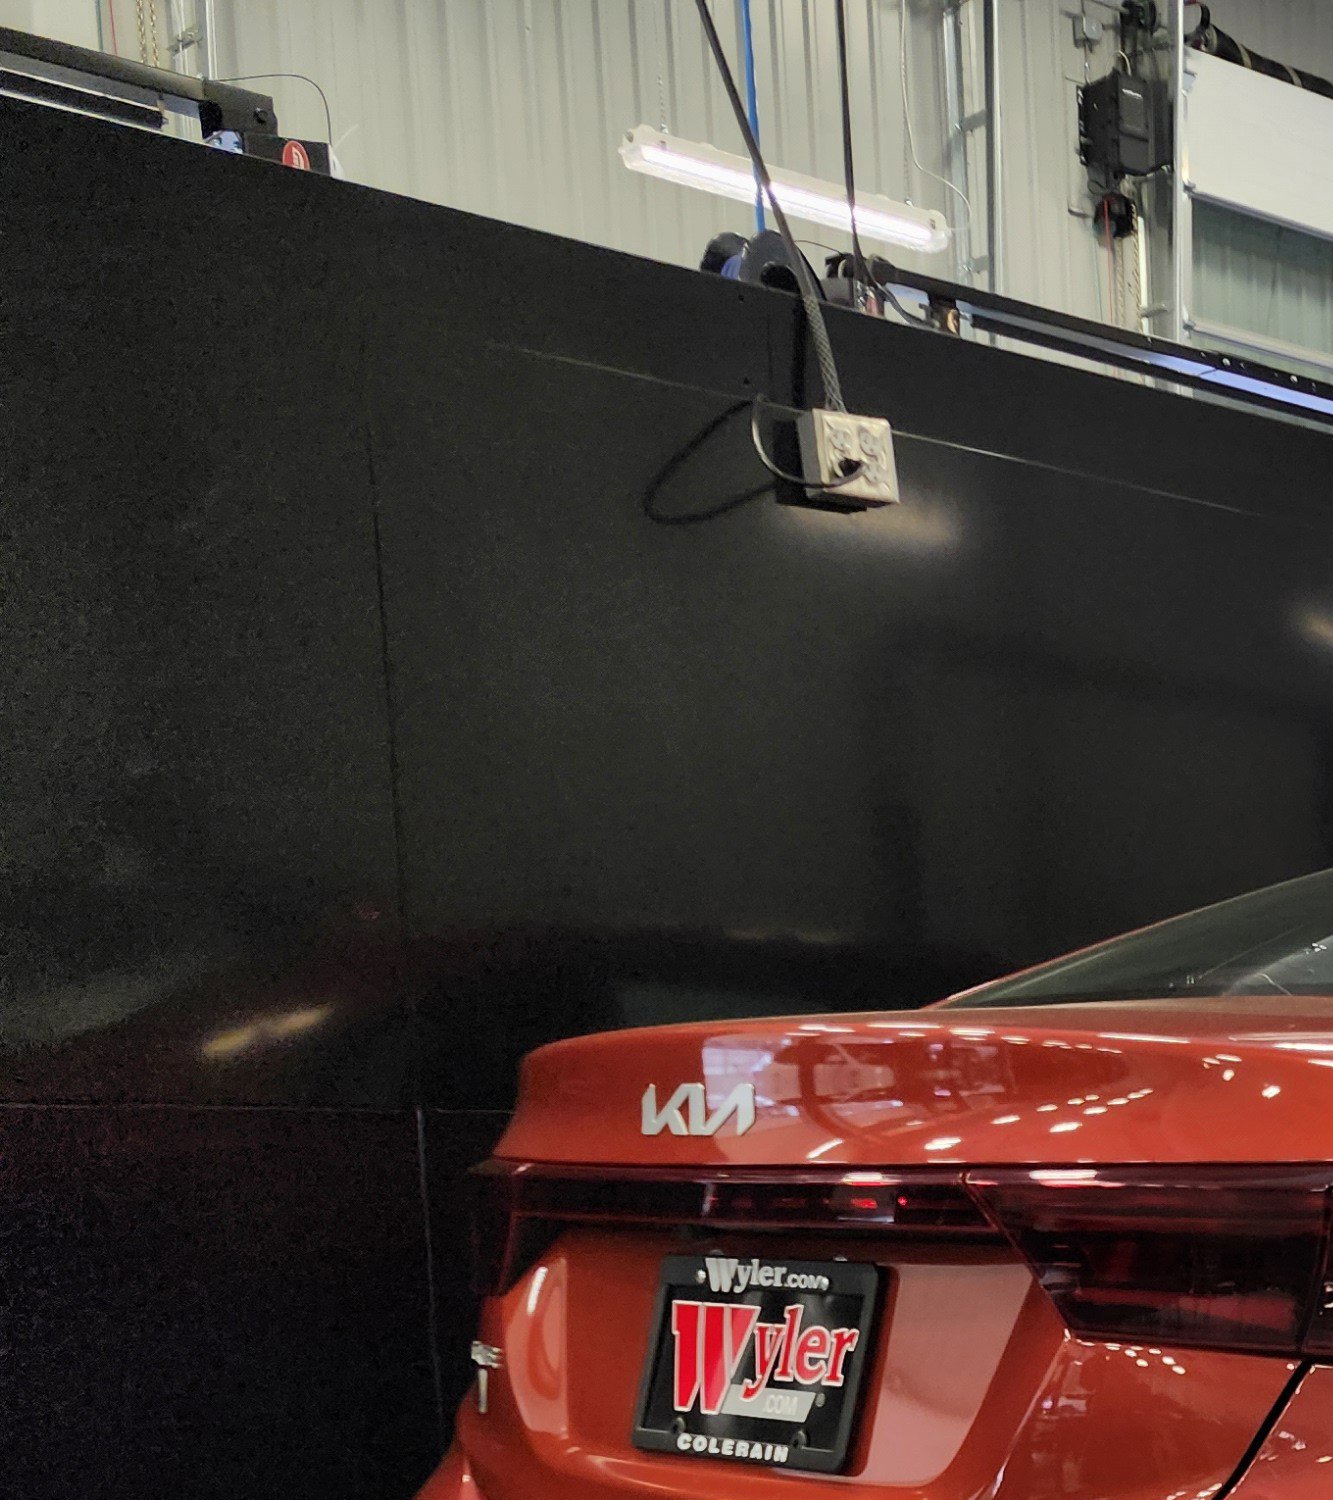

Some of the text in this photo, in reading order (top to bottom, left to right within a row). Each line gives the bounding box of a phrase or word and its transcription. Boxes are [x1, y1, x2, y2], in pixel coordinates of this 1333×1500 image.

[642, 1083, 756, 1136] KIA
[672, 1300, 860, 1416] Wyler
[677, 1432, 789, 1463] COLERAIN
